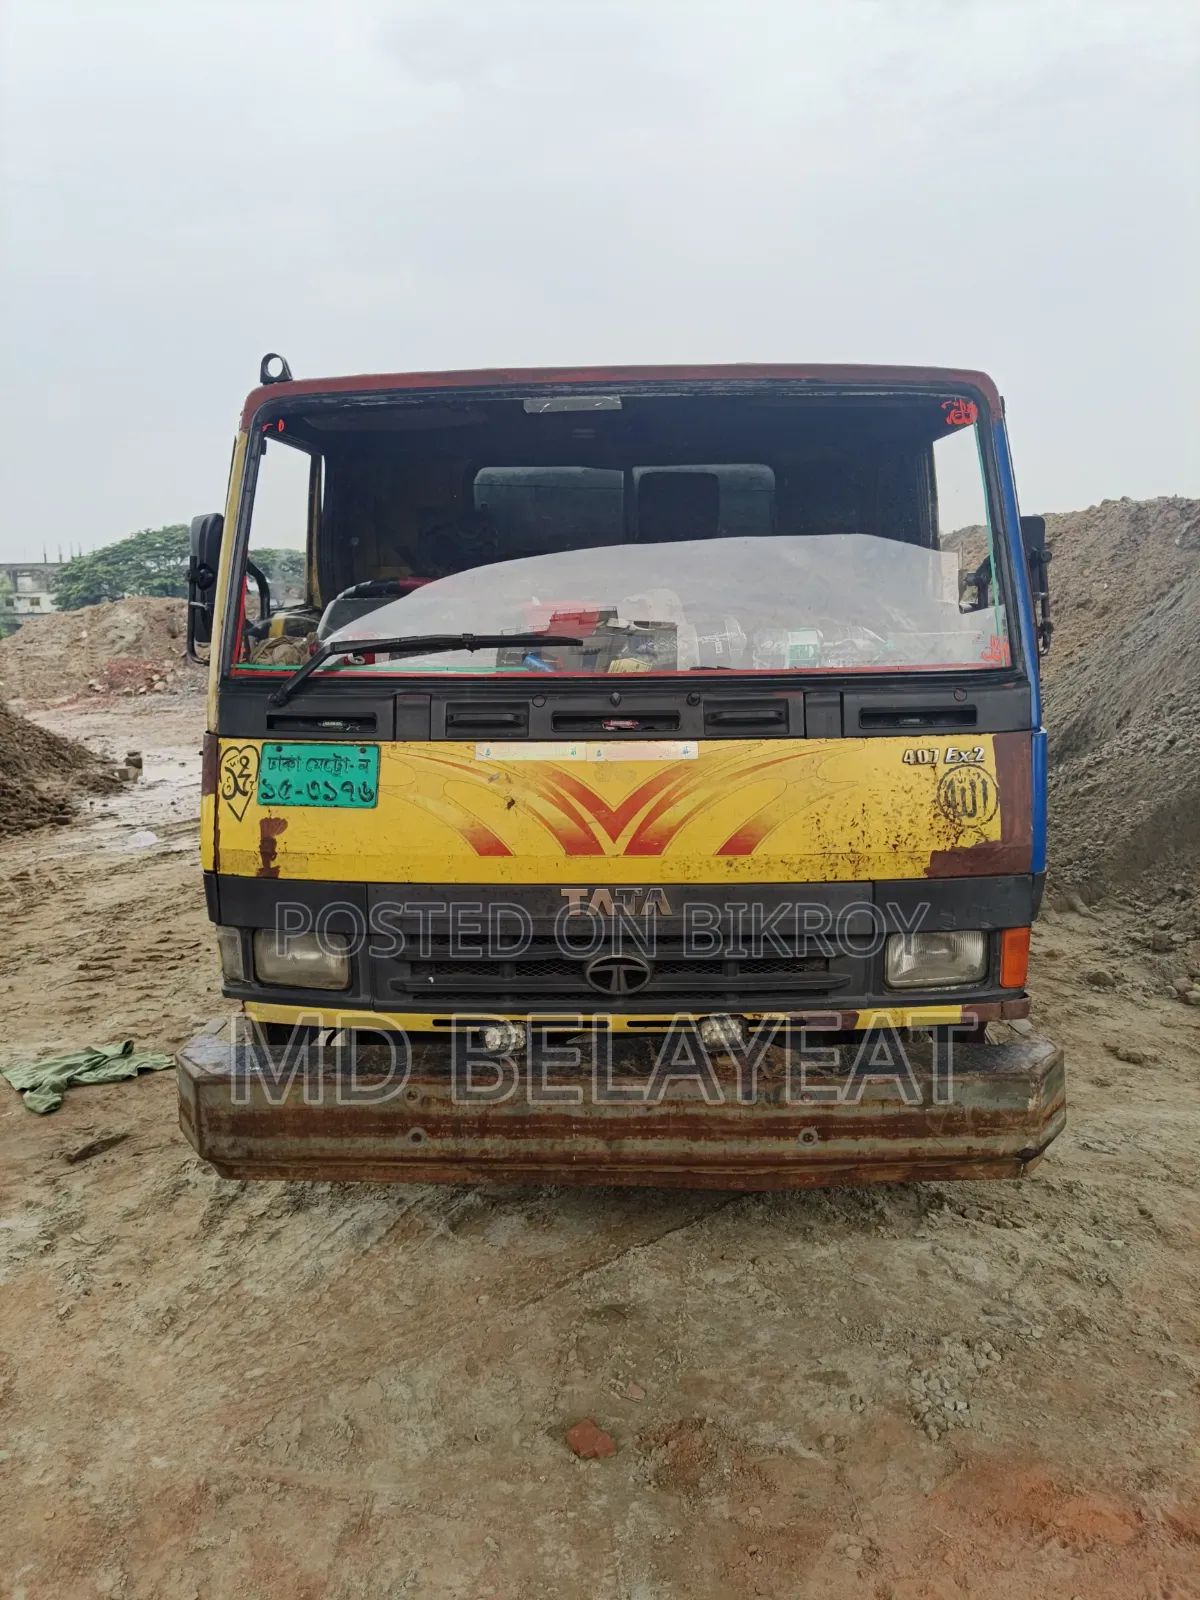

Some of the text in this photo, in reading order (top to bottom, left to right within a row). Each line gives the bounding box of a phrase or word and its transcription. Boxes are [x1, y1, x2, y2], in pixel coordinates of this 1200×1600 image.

[267, 756, 300, 773] ঢাকা
[902, 748, 940, 765] 407
[261, 778, 375, 803] ১৫-৩১৭৬
[560, 887, 673, 916] TATA
